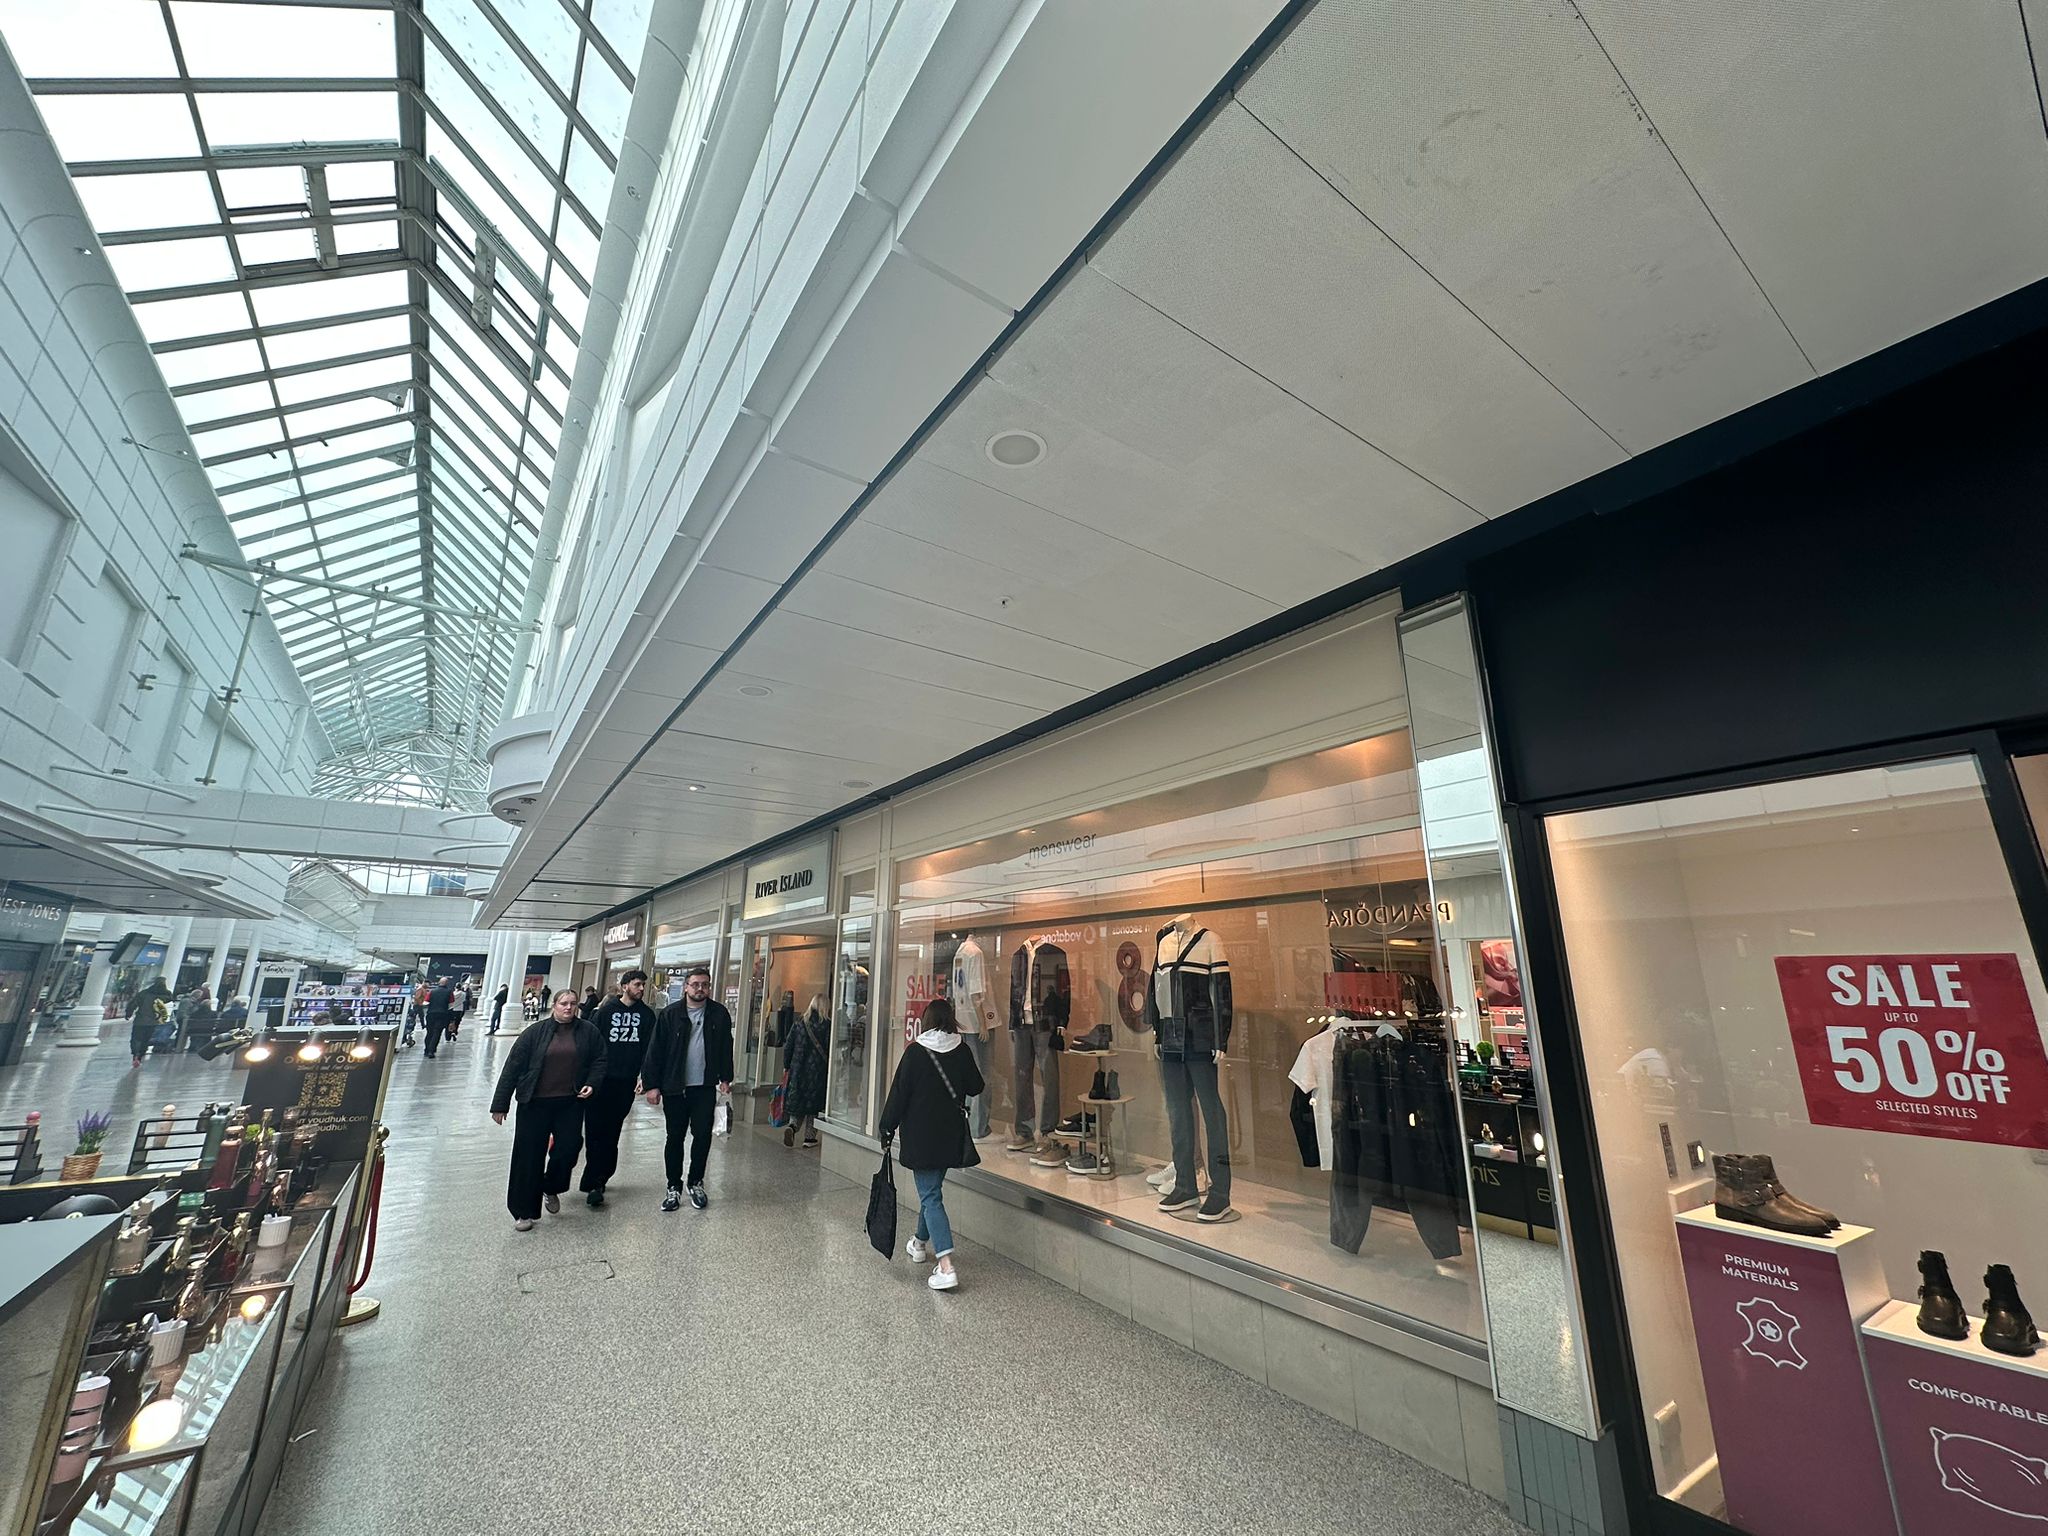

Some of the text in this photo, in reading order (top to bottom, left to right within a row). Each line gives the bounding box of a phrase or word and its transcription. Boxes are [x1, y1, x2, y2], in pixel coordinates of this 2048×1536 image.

[1029, 833, 1097, 860] menswear
[755, 869, 813, 899] RIVER ISLAND
[29, 904, 61, 920] JONES
[907, 973, 947, 1000] SALE
[1826, 964, 1971, 1008] SALE
[611, 1012, 640, 1026] SOS
[1885, 1012, 1919, 1023] UP TO
[609, 1027, 640, 1042] SZA
[1826, 1026, 2005, 1098] 50%
[1946, 1072, 2011, 1104] OFF
[1876, 1100, 1978, 1119] SELECTED STYLES
[1725, 1253, 1790, 1276] PREMIUM
[1722, 1265, 1799, 1291] MATERIALS
[1908, 1378, 2048, 1425] COMFORTABLE
